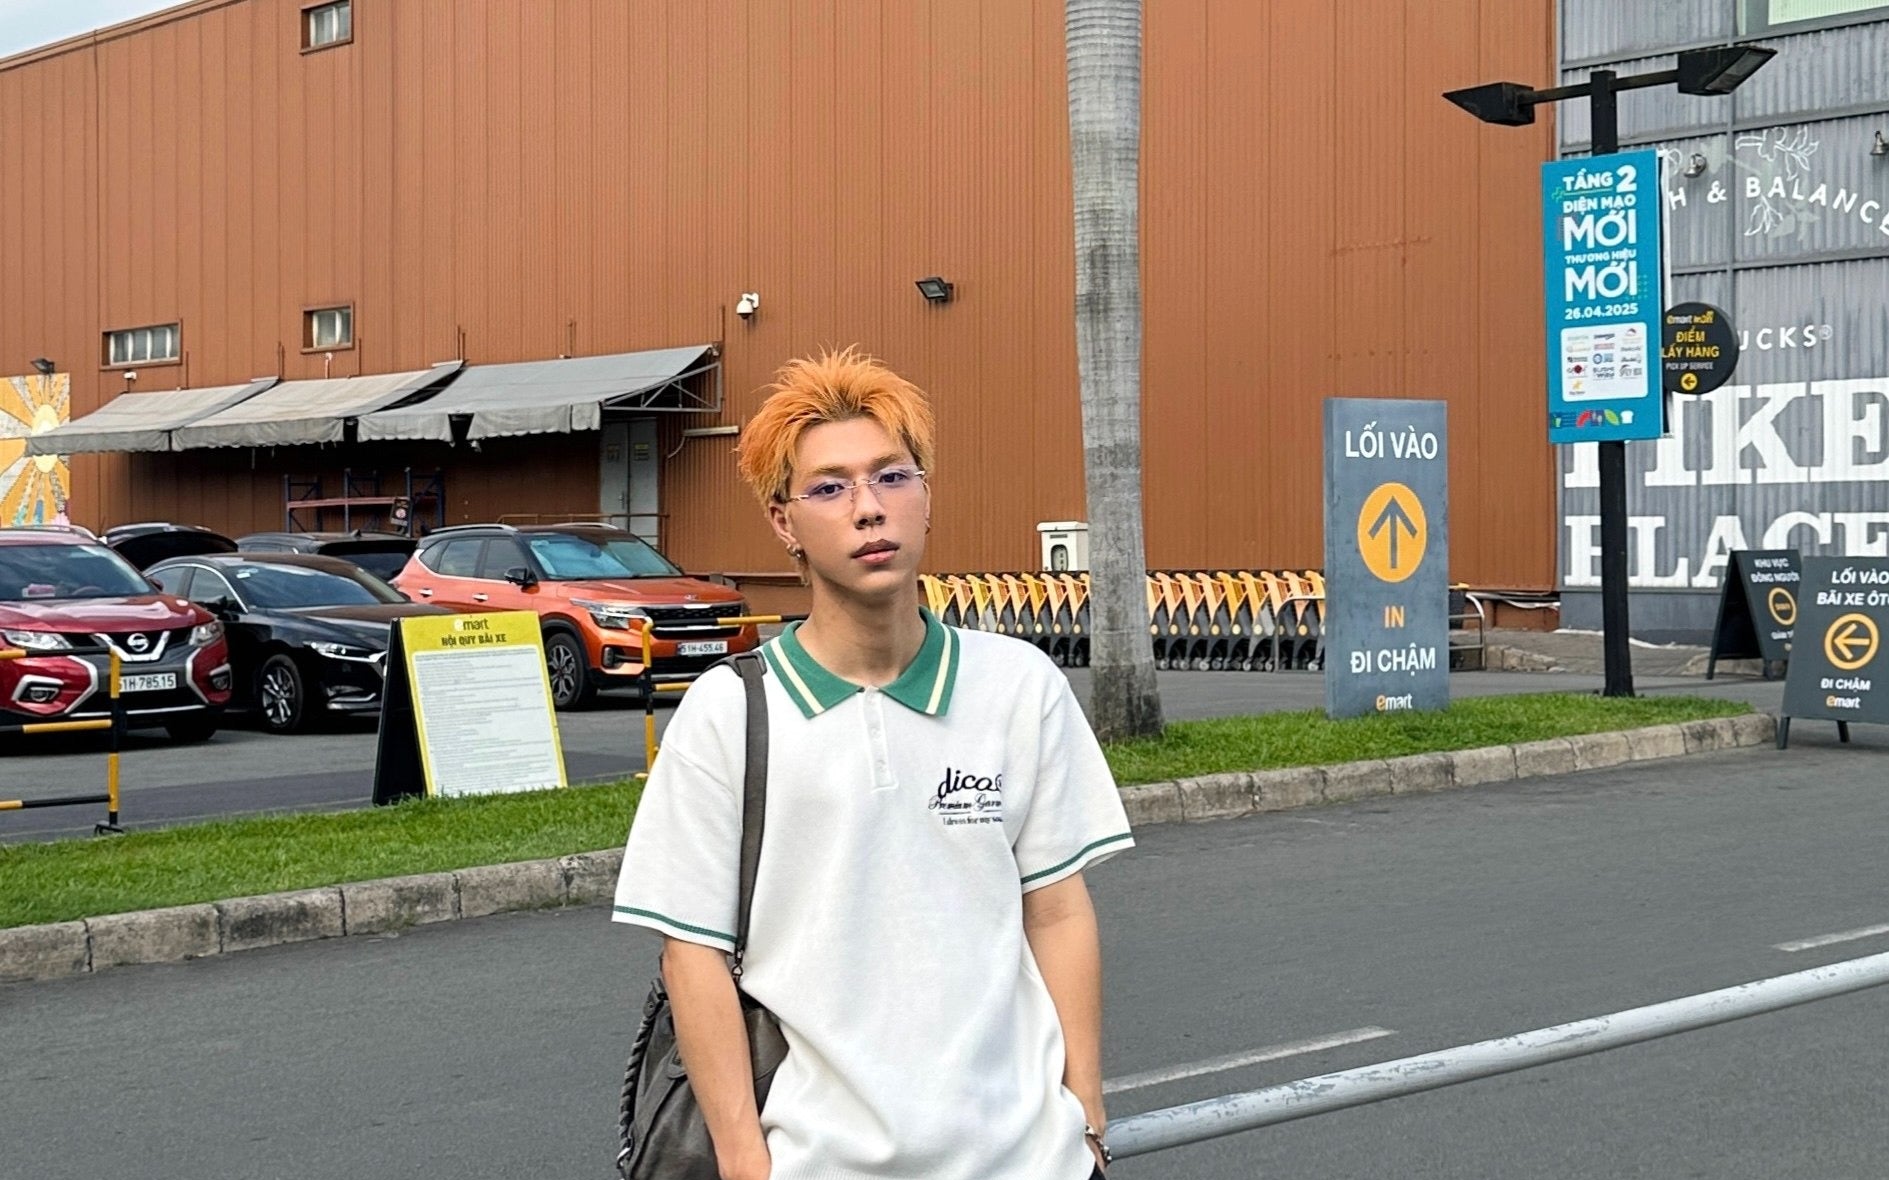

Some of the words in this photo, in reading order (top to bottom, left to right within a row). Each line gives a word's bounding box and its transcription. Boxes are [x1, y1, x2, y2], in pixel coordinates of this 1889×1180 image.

[1562, 168, 1613, 192] TẦNG
[1616, 164, 1638, 193] 2
[1562, 196, 1599, 216] DIỆN
[1601, 194, 1637, 211] MẠO
[1563, 208, 1637, 251] MỚI
[1564, 252, 1610, 264] THƯƠNG
[1564, 260, 1638, 302] MỚI
[1564, 303, 1639, 320] 26.04.2025
[1686, 344, 1720, 358] HÀNG
[1345, 421, 1384, 459] LỐI
[1389, 424, 1438, 460] VÀO
[1831, 566, 1856, 584] LỐI
[1816, 590, 1842, 606] BÃI
[1844, 592, 1865, 606] XE
[1384, 605, 1405, 628] IN
[1350, 650, 1372, 674] ĐI
[1377, 642, 1436, 677] CHẬM
[1821, 677, 1834, 689] ĐI
[1835, 677, 1871, 692] CHẬM
[1376, 693, 1413, 711] emart
[1826, 695, 1861, 709] emart
